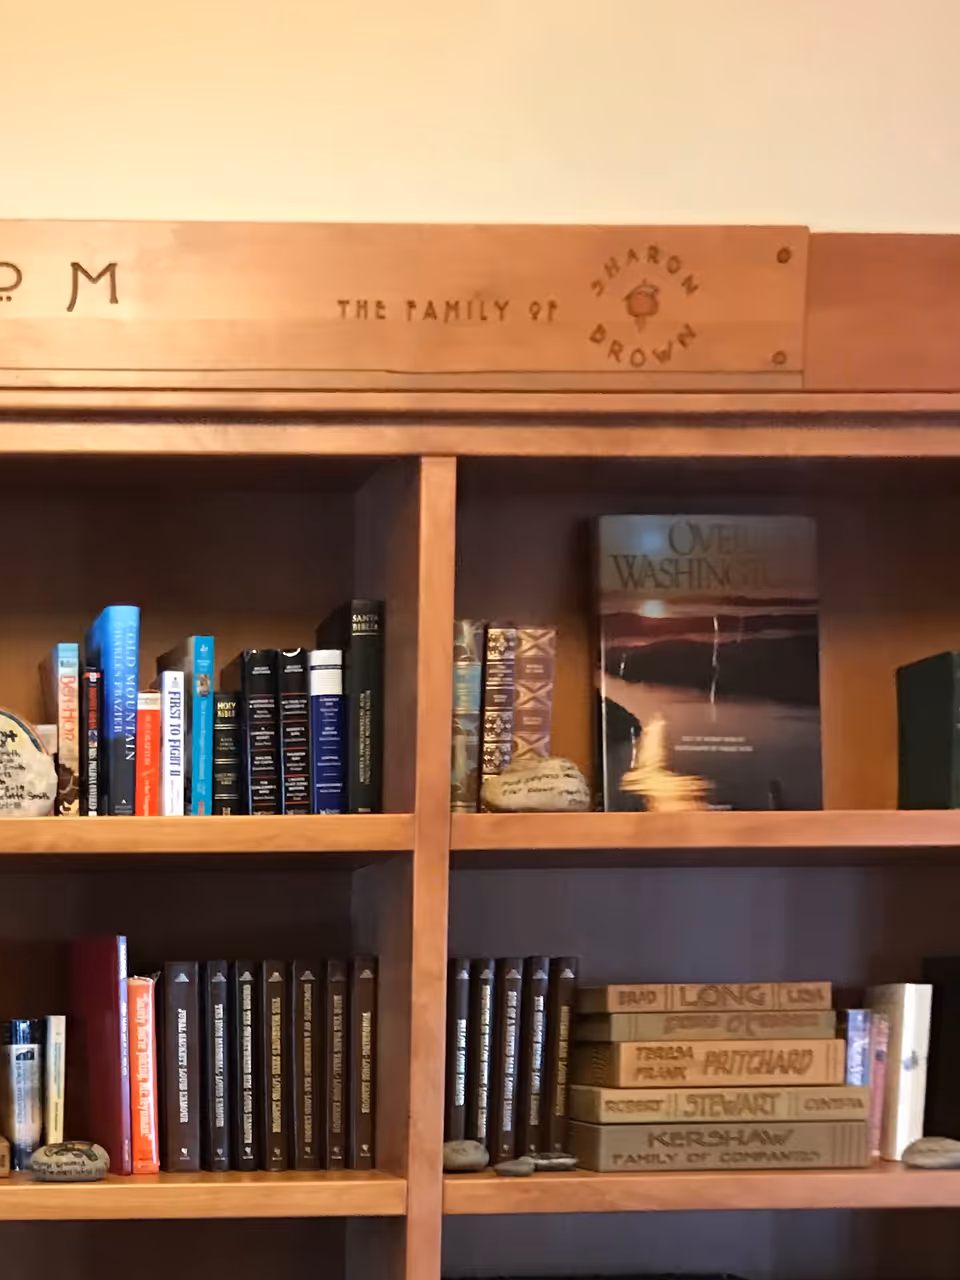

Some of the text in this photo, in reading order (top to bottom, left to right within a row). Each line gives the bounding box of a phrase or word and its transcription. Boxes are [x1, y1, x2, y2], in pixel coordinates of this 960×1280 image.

[590, 244, 703, 297] SHARON
[337, 299, 560, 323] THE FAMILY OF
[588, 322, 699, 368] BROWN
[113, 621, 124, 733] CHARLES FRAZIER
[125, 621, 136, 761] COLD MOUNTAIN
[168, 691, 181, 720] FIRST
[217, 701, 236, 710] HOLY
[217, 710, 236, 718] BIBLE
[169, 723, 181, 736] TO
[168, 738, 181, 767] FIGHT
[679, 985, 767, 1007] LONG
[178, 1008, 188, 1123] JUBAL SACKETT LOUIS L'AMOUR
[456, 1050, 466, 1073] LOUIS
[636, 1046, 694, 1062] TERESA
[702, 1049, 814, 1076] PRITCHARD
[361, 1058, 371, 1081] LOUIS
[214, 1075, 224, 1098] LOUIS
[503, 1076, 513, 1099] LOUIS
[214, 1098, 224, 1128] L'AMOUR
[272, 1077, 281, 1133] LOUIS L'AMOUR
[303, 1094, 312, 1114] LOUIS
[683, 1092, 782, 1116] STEWART
[242, 1091, 252, 1144] LOUIS L'AMOUR
[647, 1129, 795, 1148] KERSHAW
[611, 1151, 821, 1165] FAMILY OF COMPANIES
